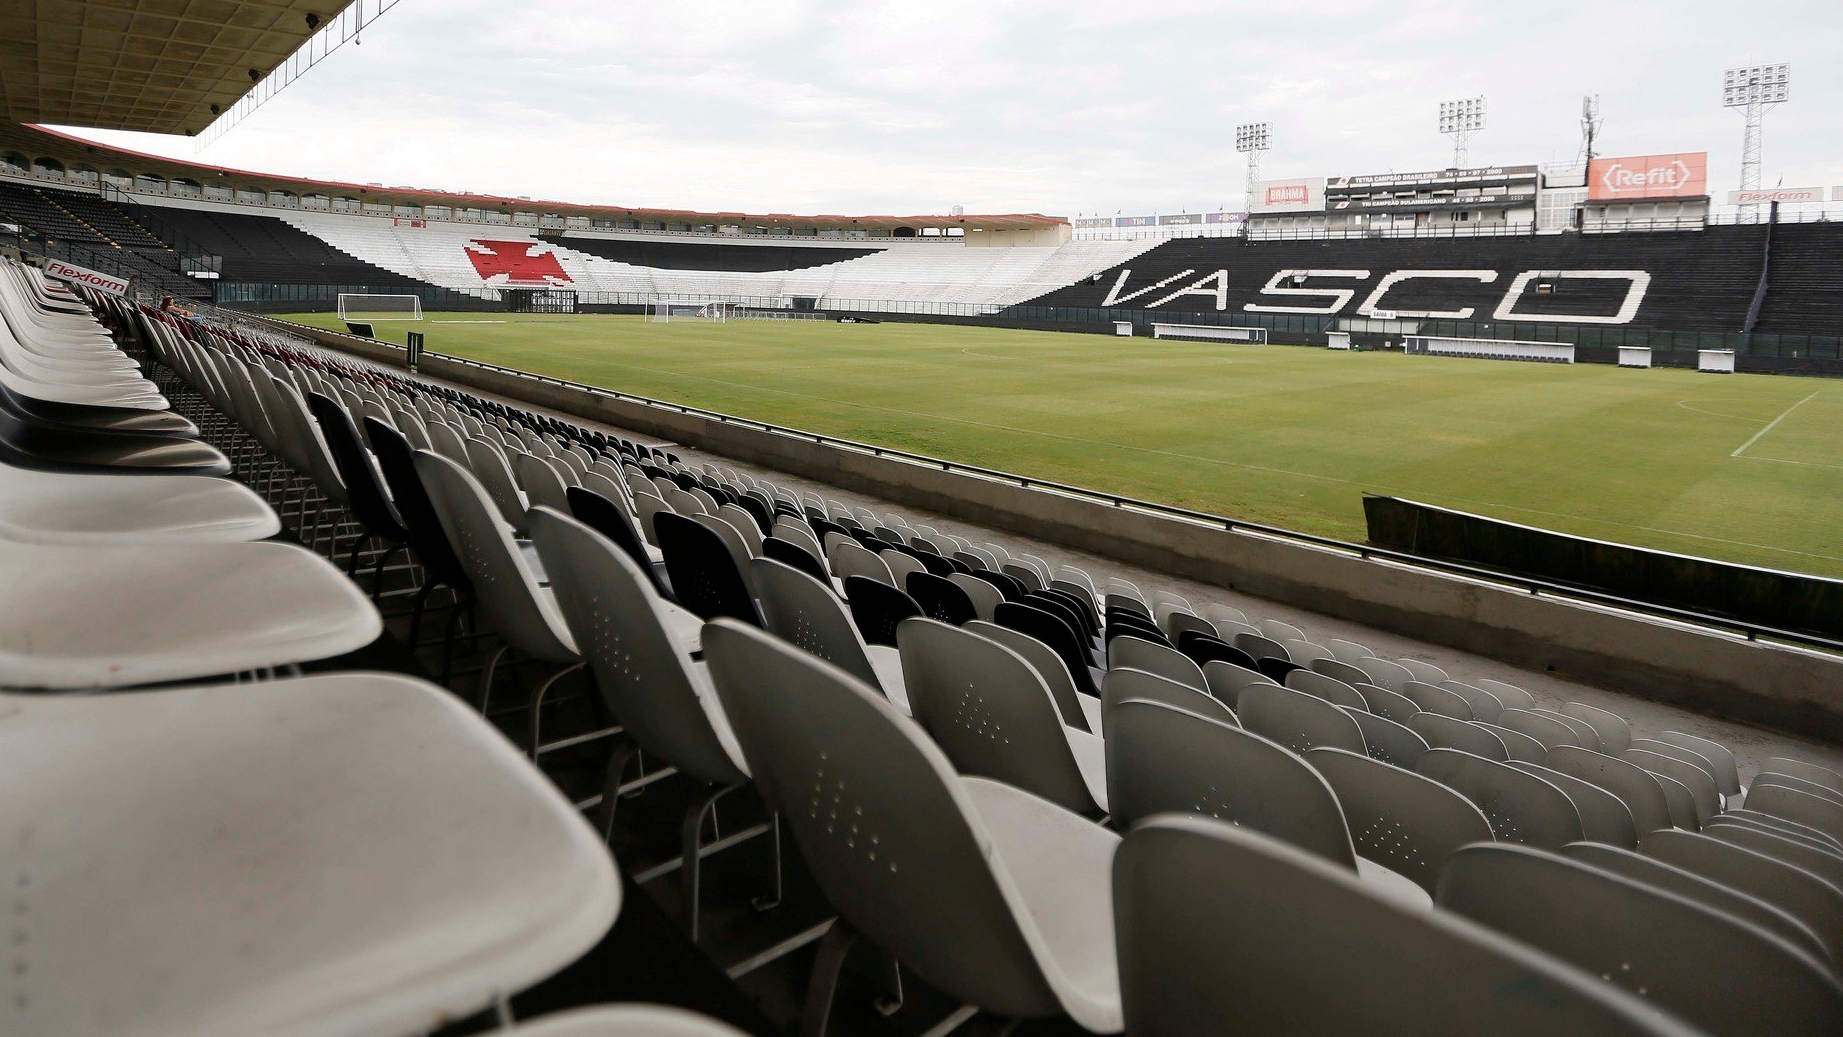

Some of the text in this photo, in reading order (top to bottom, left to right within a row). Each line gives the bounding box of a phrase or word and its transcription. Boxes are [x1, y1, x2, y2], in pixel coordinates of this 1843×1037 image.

[1374, 174, 1402, 182] CAMPEÃO
[1615, 168, 1676, 186] Refit
[1270, 188, 1304, 200] BRAHMA
[1738, 191, 1811, 201] Flexform
[48, 263, 125, 292] Flexform
[1102, 269, 1651, 324] VASCO
